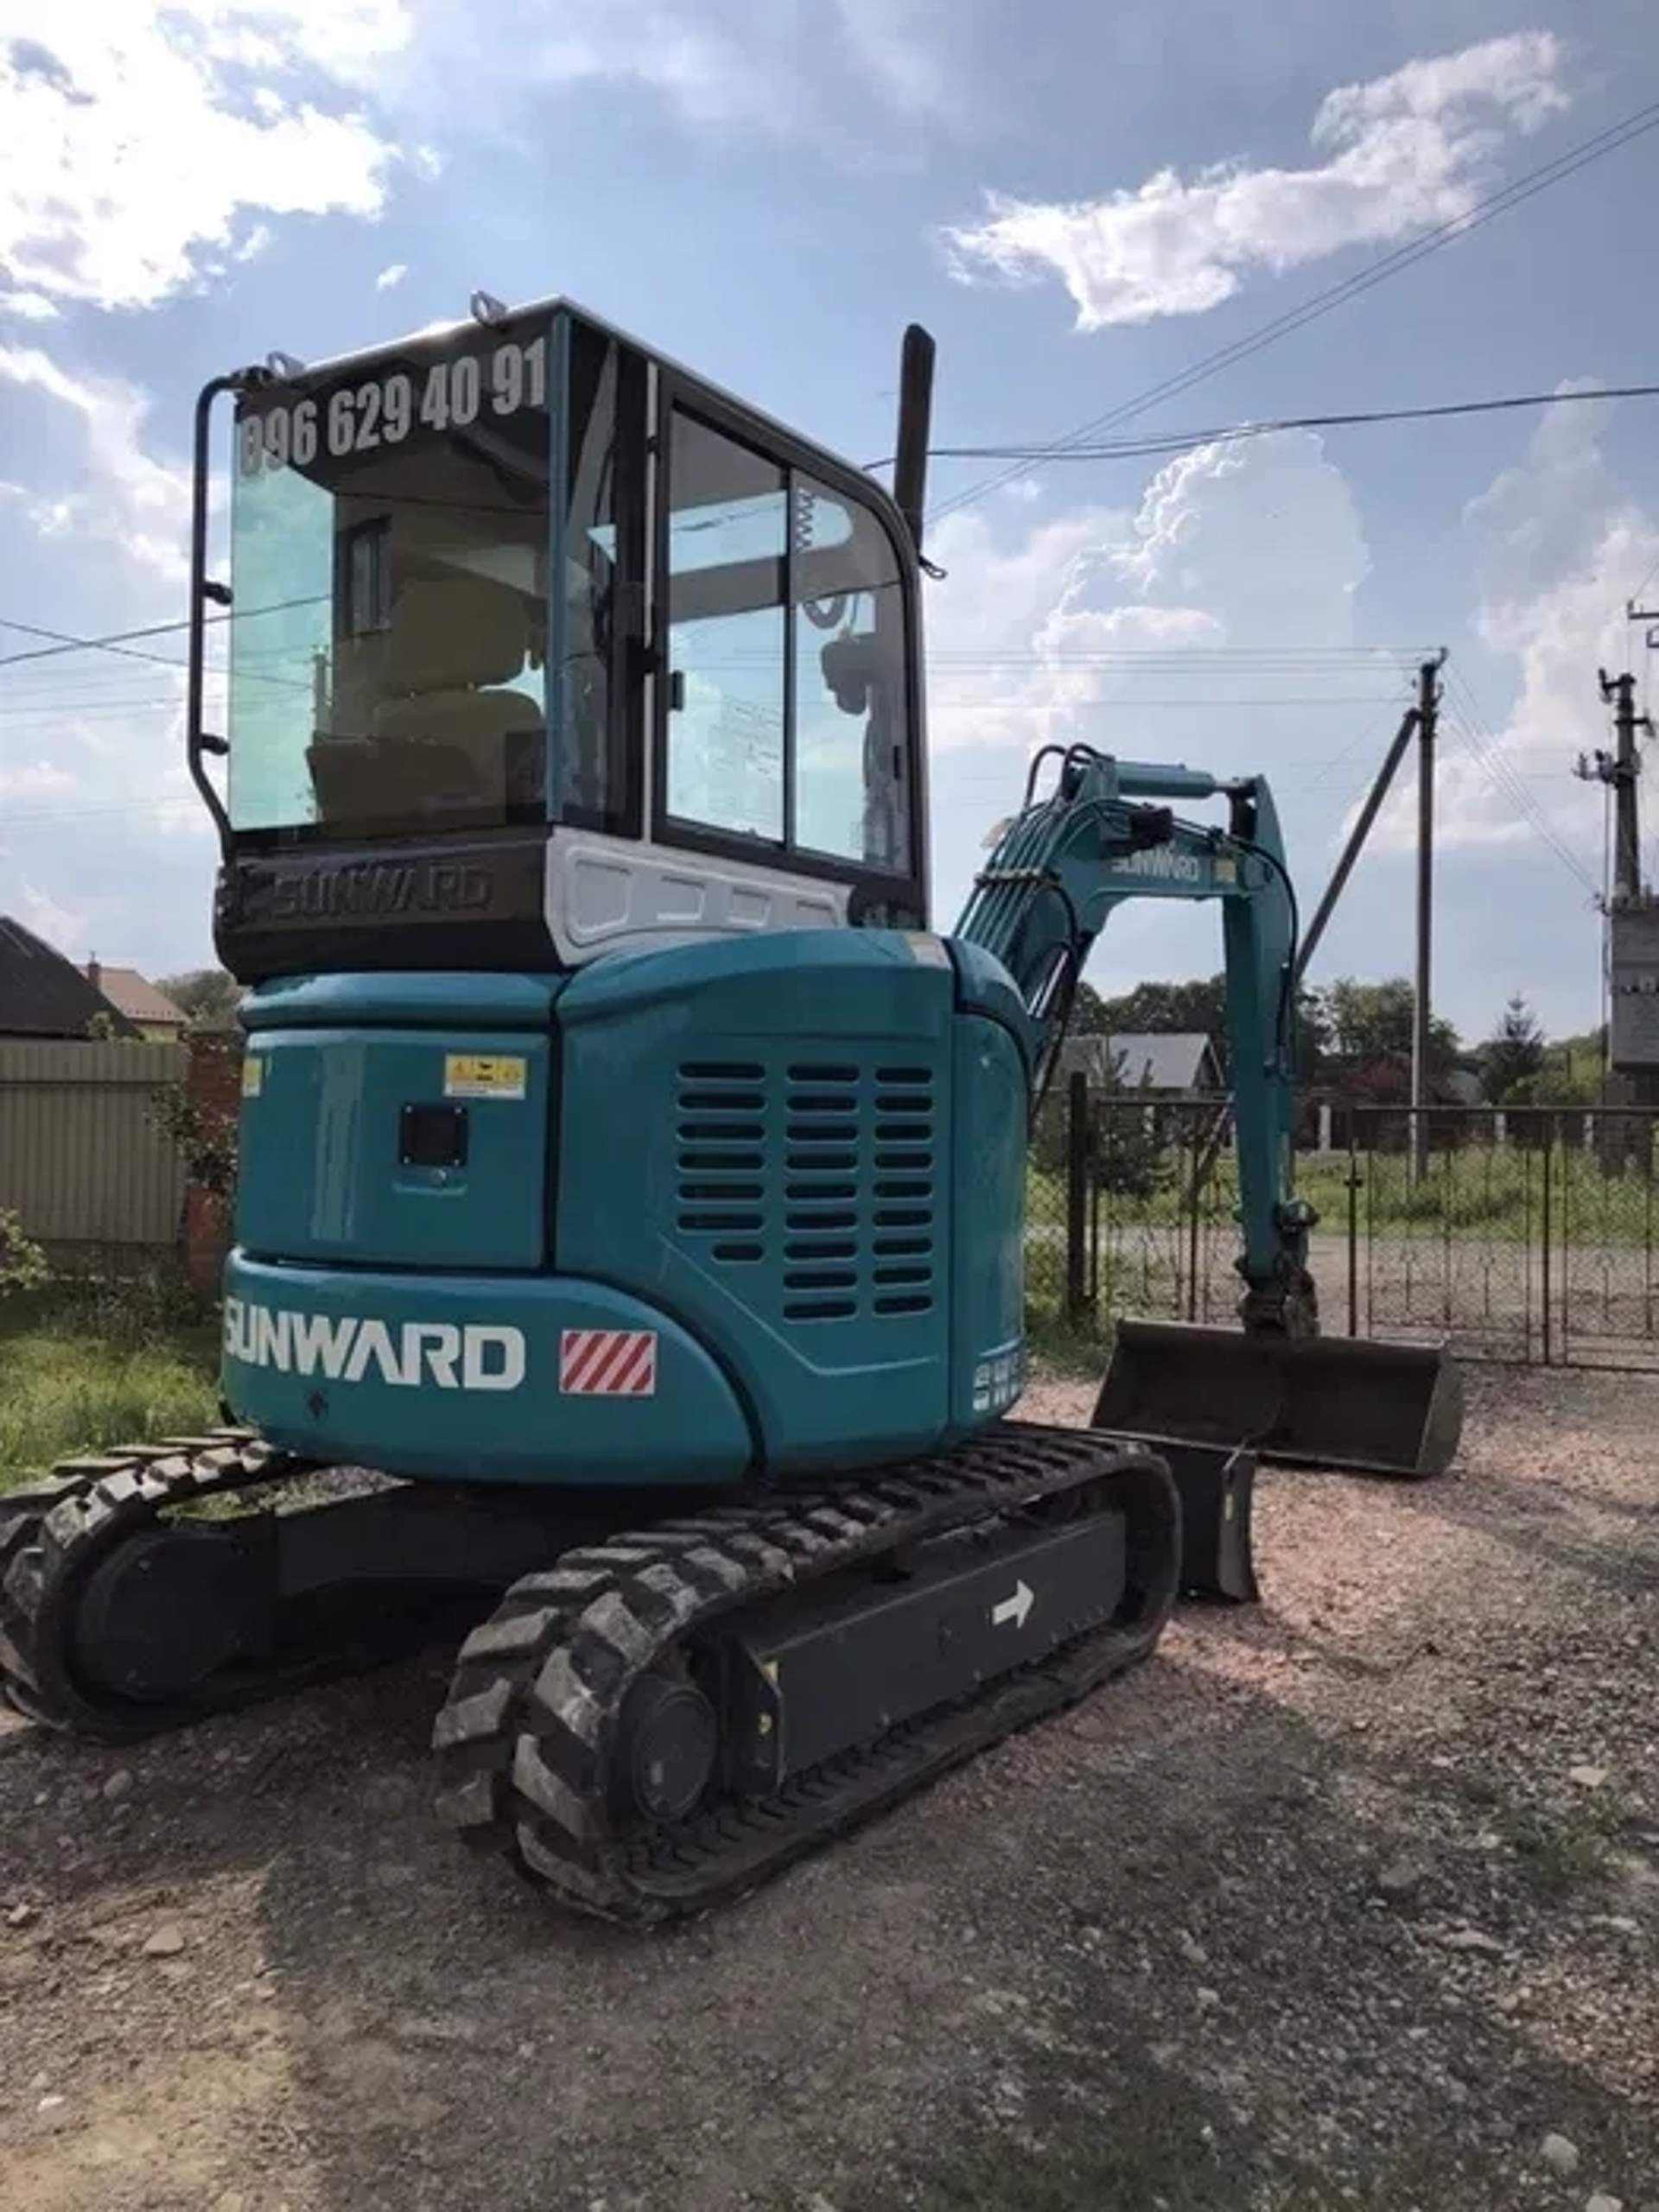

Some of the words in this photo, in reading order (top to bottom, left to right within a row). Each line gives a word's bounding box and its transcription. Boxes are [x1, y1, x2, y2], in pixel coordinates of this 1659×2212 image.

[327, 373, 411, 456] 629
[421, 355, 480, 431] 40
[492, 337, 545, 416] 91
[273, 865, 494, 918] SUNWARD
[225, 1296, 525, 1391] SUNWARD
